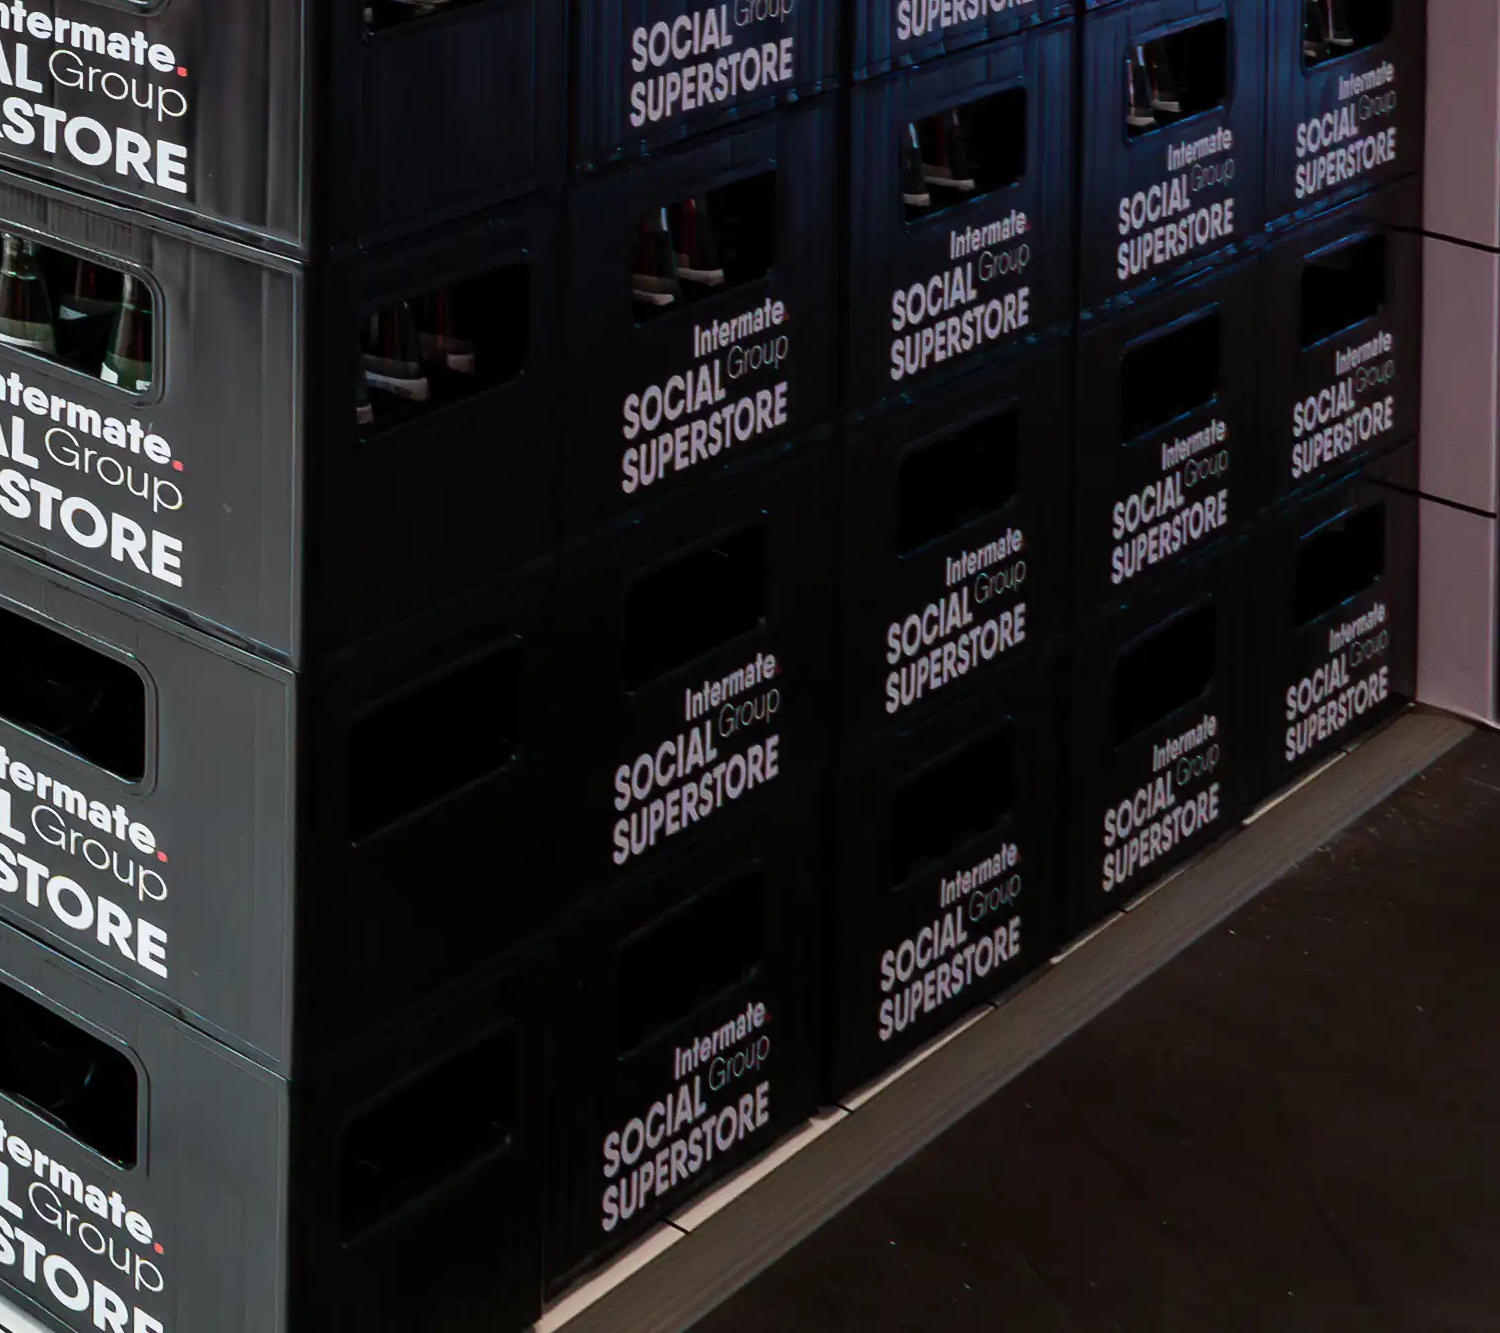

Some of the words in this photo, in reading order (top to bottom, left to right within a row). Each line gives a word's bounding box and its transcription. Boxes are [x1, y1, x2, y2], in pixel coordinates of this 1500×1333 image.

[632, 4, 732, 72] SOCIAL
[49, 50, 187, 122] Group
[630, 37, 793, 126] SUPERSTORE
[892, 262, 977, 330] SOCIAL
[979, 244, 1029, 281] Group
[727, 338, 788, 380] Group
[891, 287, 1029, 380] SUPERSTORE
[623, 359, 726, 439] SOCIAL
[623, 383, 787, 493] SUPERSTORE
[45, 428, 182, 513] Group
[718, 695, 779, 737] Group
[613, 734, 778, 864] SUPERSTORE
[615, 720, 717, 810] SOCIAL
[31, 805, 167, 901] Group
[968, 882, 1020, 922] Group
[879, 915, 1019, 1041] SUPERSTORE
[881, 906, 968, 991] SOCIAL
[29, 1182, 163, 1292] Group
